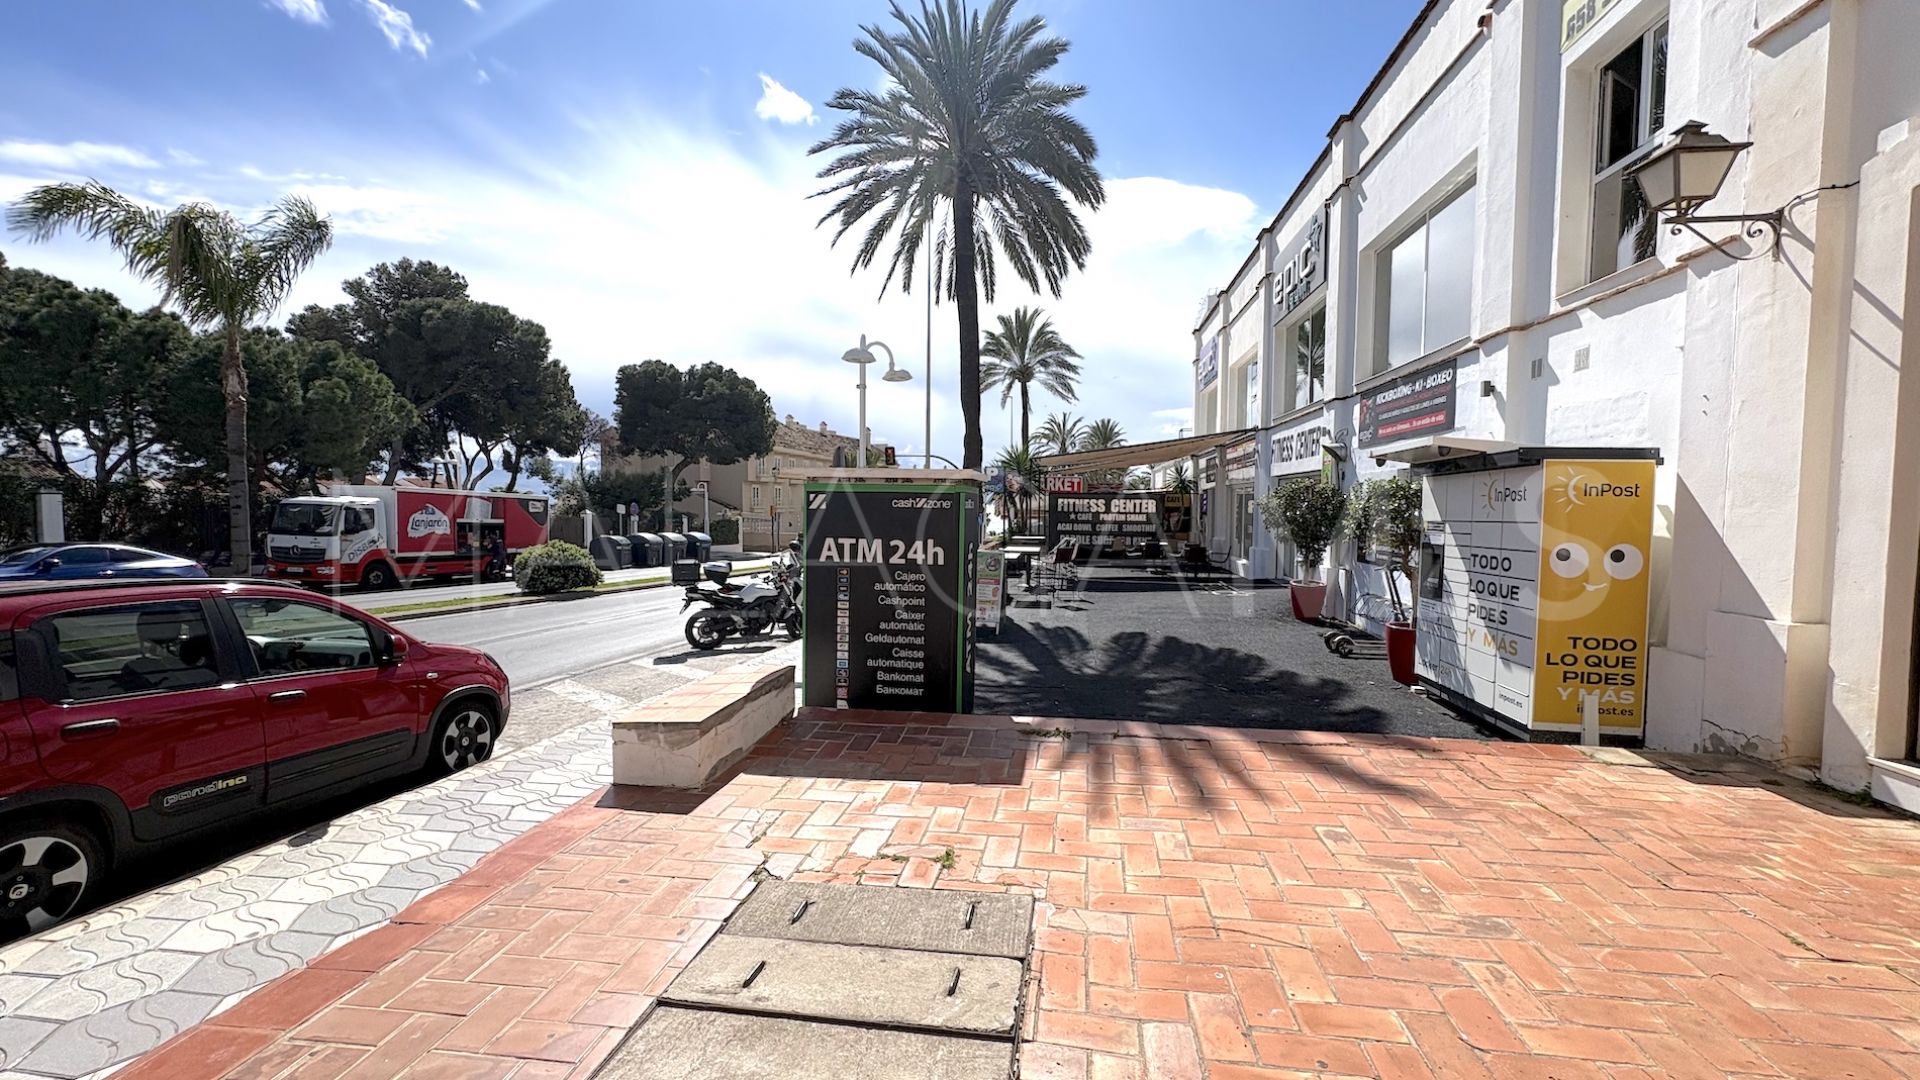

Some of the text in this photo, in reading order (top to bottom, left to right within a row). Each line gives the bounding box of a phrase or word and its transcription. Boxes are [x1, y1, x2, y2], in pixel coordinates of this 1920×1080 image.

[1295, 426, 1321, 461] CENTER
[1494, 485, 1527, 502] InPost
[1583, 482, 1640, 498] InPost
[1057, 498, 1157, 513] FITNESS CENTER
[818, 537, 945, 565] ATM 24h
[1470, 553, 1512, 572] TODO
[894, 570, 926, 583] Cajero
[873, 582, 926, 593] automático
[877, 595, 926, 607] Cashpoint
[894, 609, 926, 620] Caixer
[1467, 603, 1508, 626] PIDES
[864, 633, 925, 645] Geldautomat
[1467, 627, 1519, 656] Y MÁS
[1567, 636, 1637, 652] TODO
[892, 647, 925, 659] Caisse
[1546, 652, 1637, 669] LO QUE
[866, 658, 925, 671] automatique
[876, 671, 925, 683] Bankomat
[1562, 670, 1636, 687] PIDES
[876, 684, 925, 697] Банкомат
[1556, 686, 1573, 701] Y
[1576, 703, 1634, 716] iost.es
[163, 775, 248, 807] pandino
